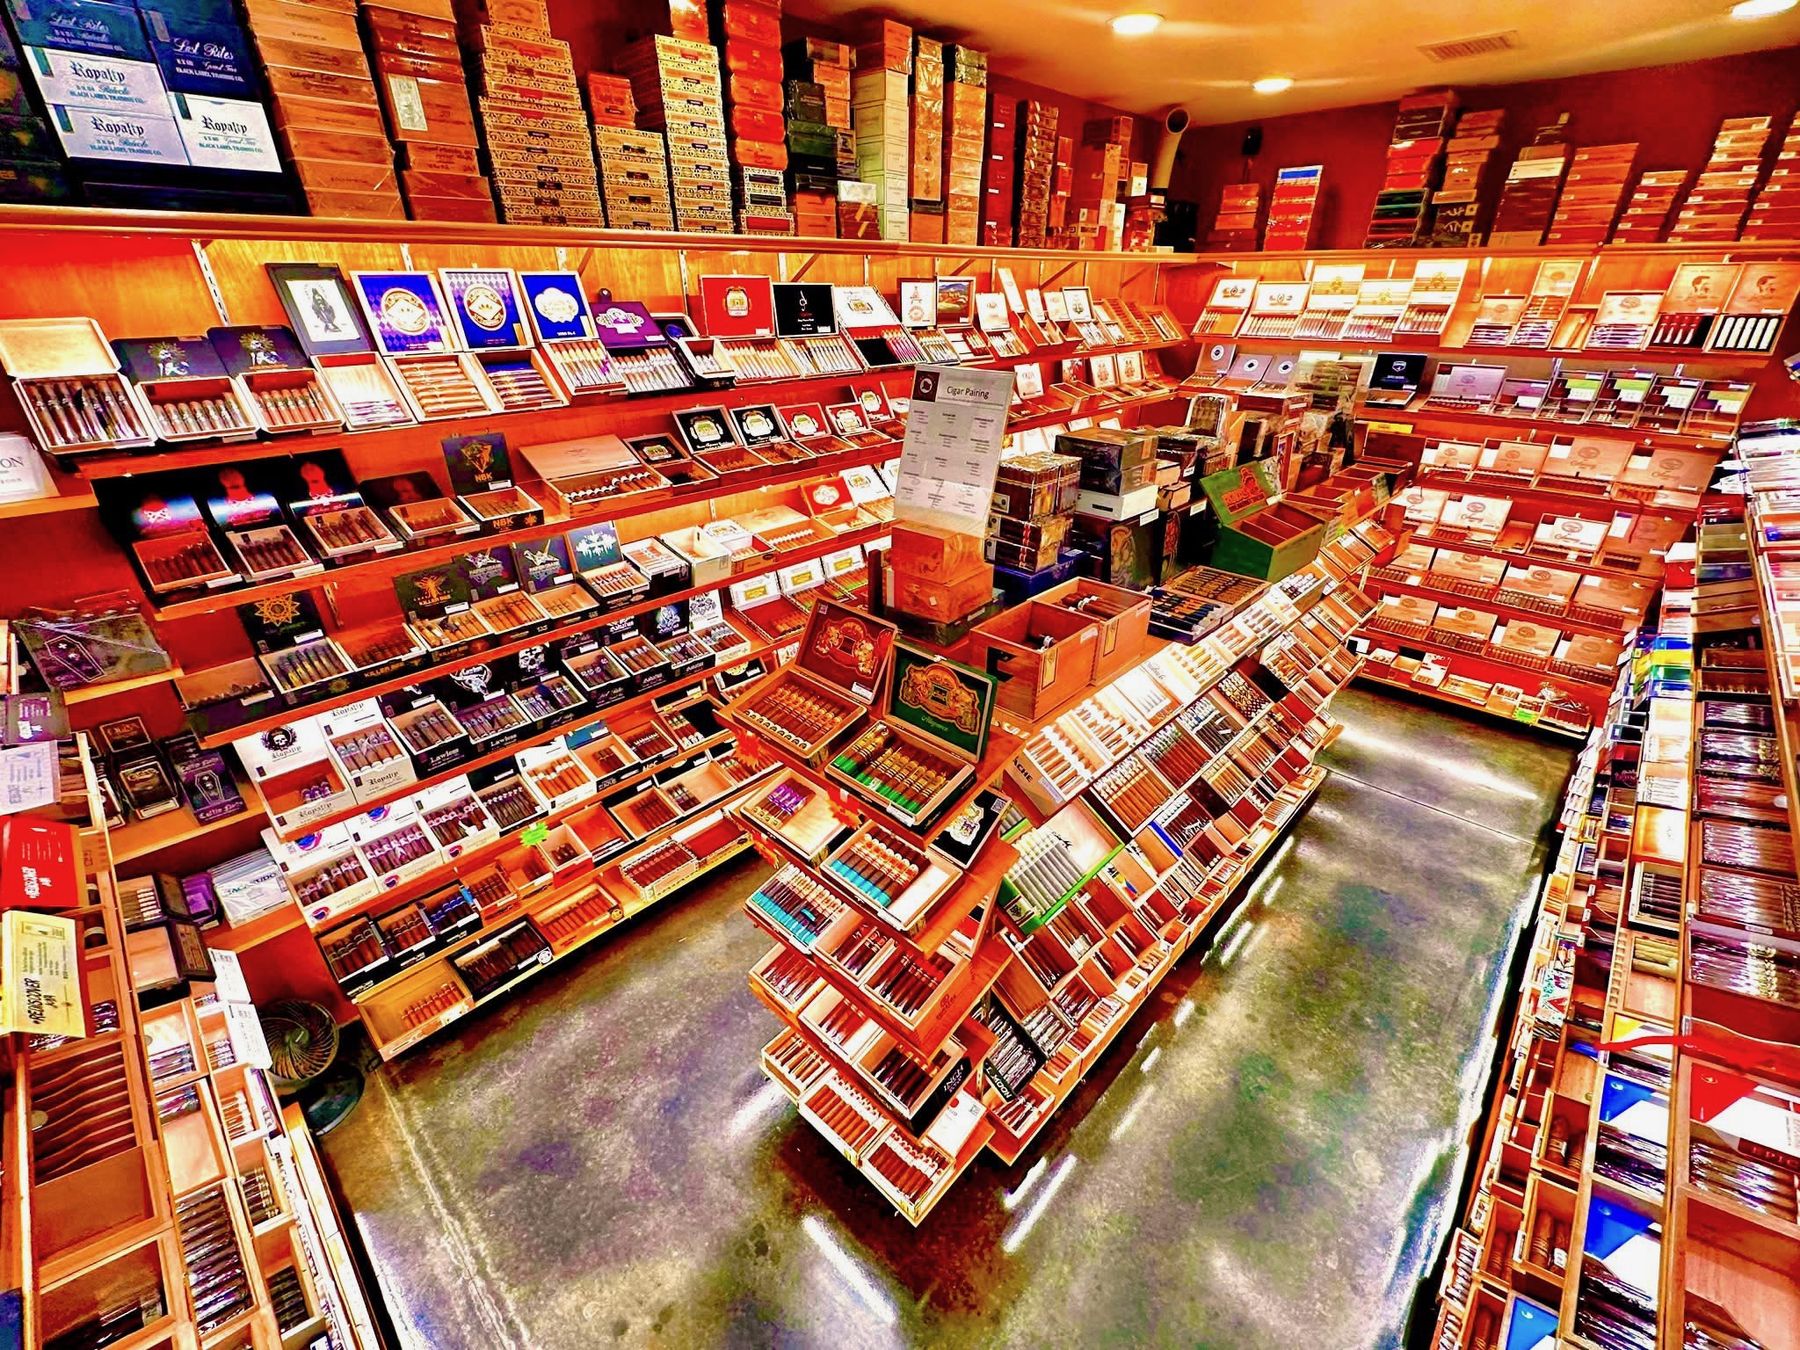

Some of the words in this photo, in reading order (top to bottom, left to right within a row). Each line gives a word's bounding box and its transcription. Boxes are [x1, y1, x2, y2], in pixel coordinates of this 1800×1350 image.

[173, 38, 200, 55] Last
[203, 43, 234, 60] Rites
[70, 60, 125, 83] Royalty
[211, 72, 234, 80] TRADING
[91, 115, 145, 137] Royalty
[201, 114, 248, 136] Royalty
[946, 385, 964, 396] Cigar
[964, 387, 990, 400] Pairing
[475, 472, 493, 482] NBK
[492, 517, 514, 528] NBK
[430, 748, 460, 763] Lawless
